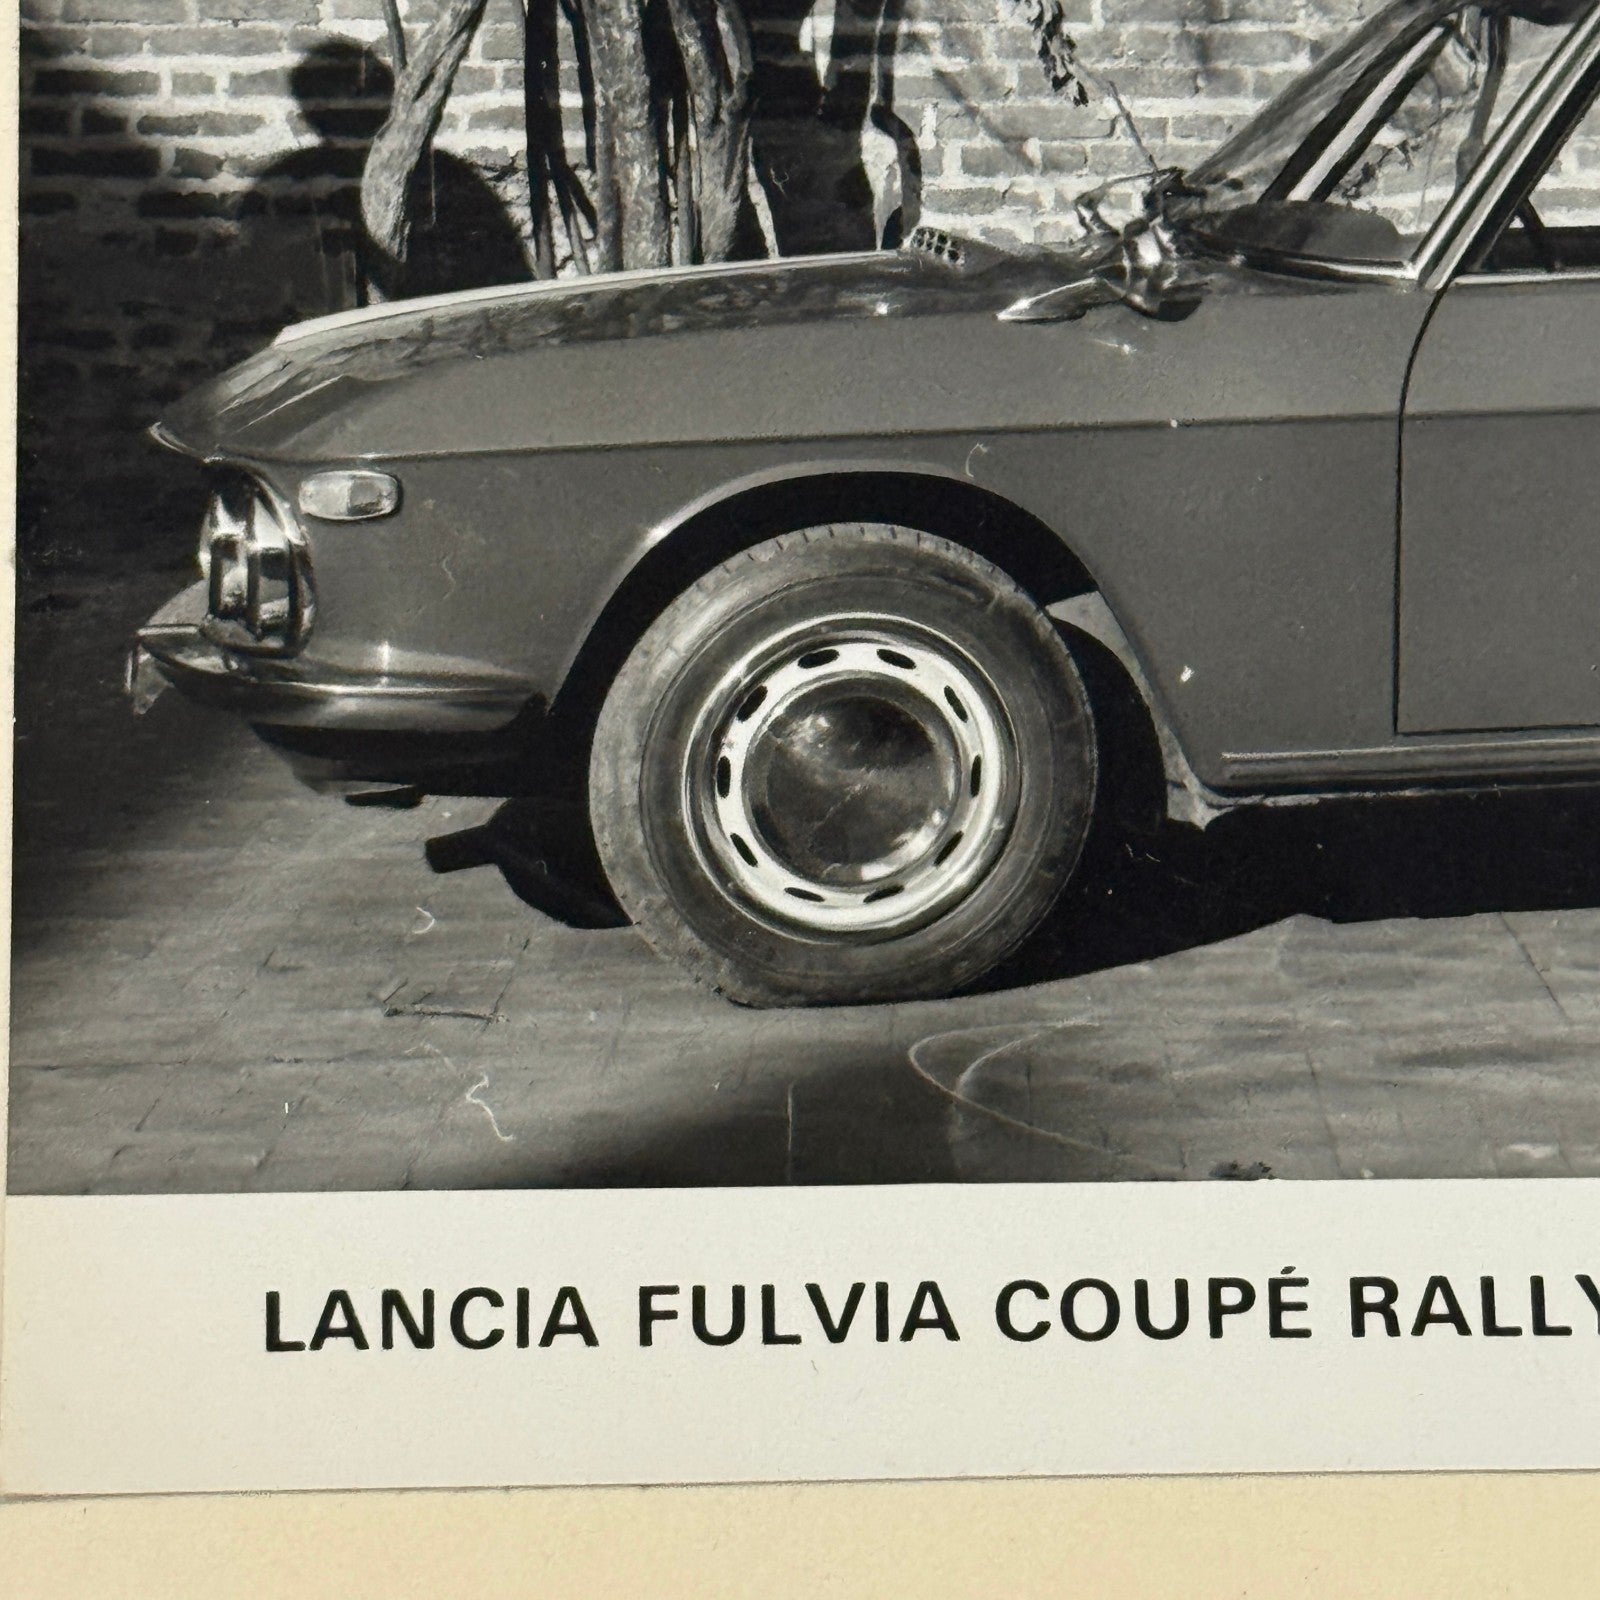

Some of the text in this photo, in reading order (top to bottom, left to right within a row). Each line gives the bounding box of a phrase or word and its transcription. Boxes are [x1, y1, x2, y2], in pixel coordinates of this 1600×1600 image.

[265, 1286, 600, 1353] LANCIA
[638, 1281, 961, 1347] FULVIA
[995, 1265, 1313, 1343] COUPÉ
